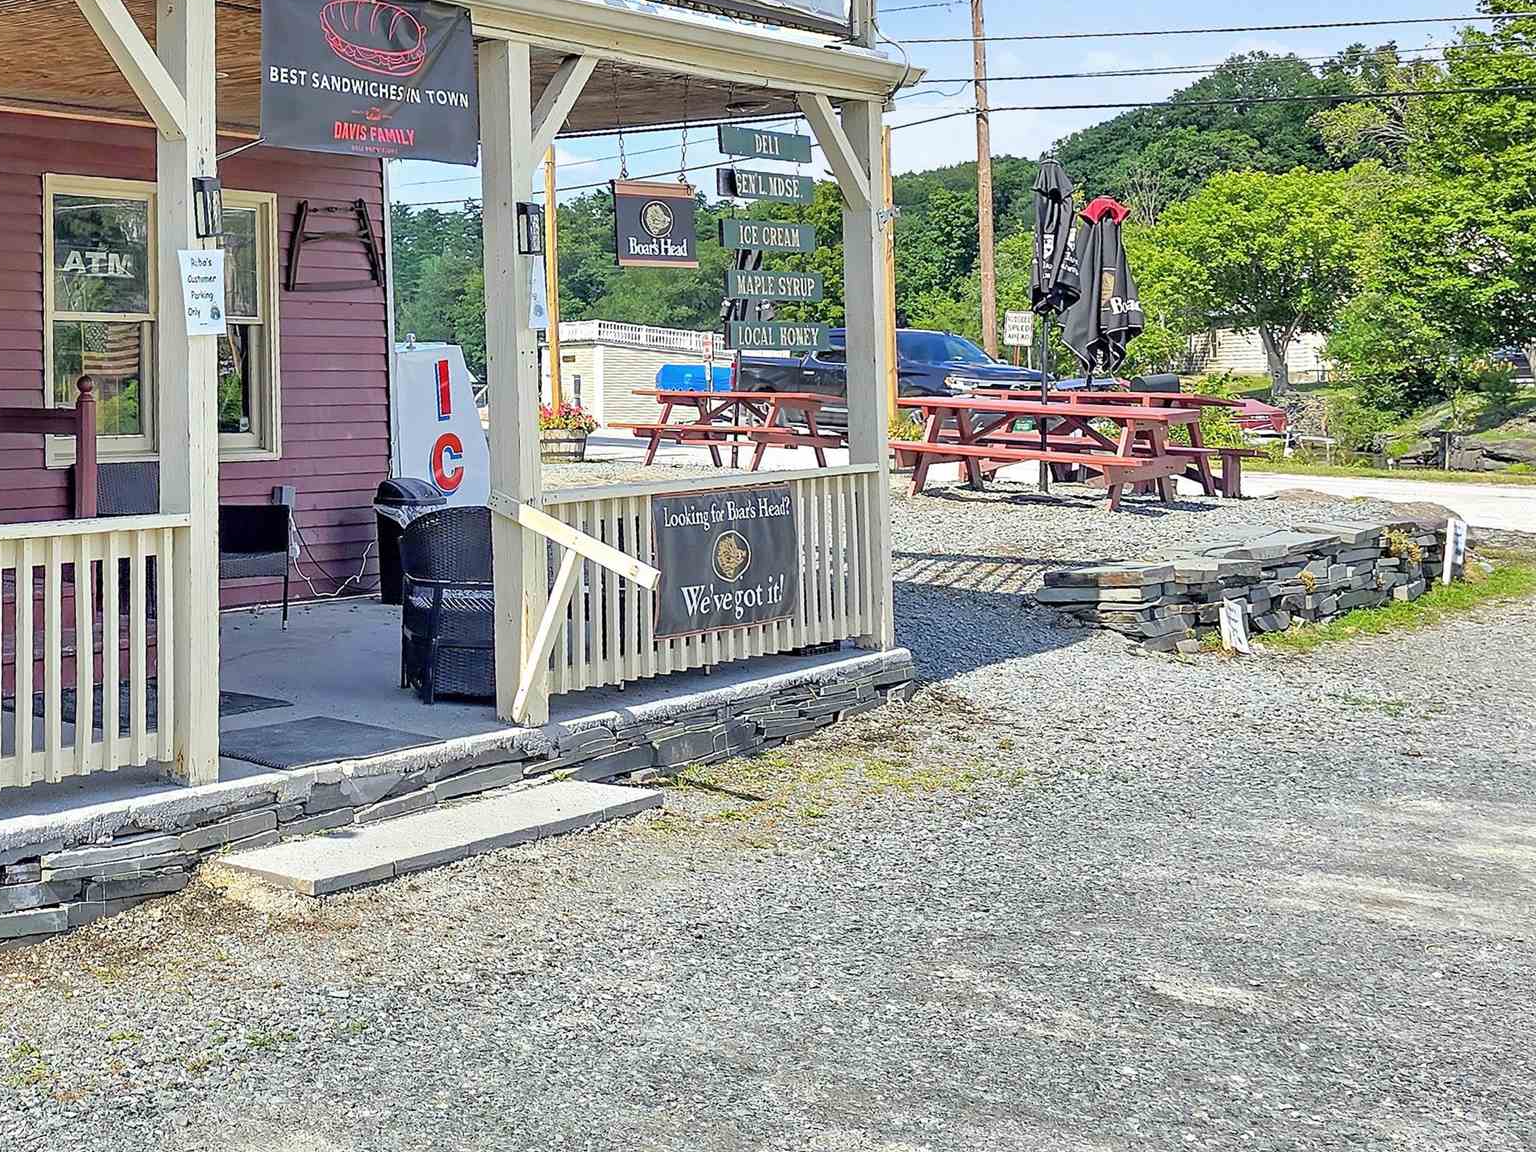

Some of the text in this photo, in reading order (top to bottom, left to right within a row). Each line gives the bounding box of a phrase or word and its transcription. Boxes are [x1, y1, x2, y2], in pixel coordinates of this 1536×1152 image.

[269, 65, 470, 109] BEST SANDWICHES IN TOWN
[333, 120, 415, 147] DAVIS FAMILY
[754, 133, 780, 155] DELI
[768, 176, 804, 199] MDSE.
[628, 236, 688, 257] Boar's Head
[739, 224, 801, 248] ICE CREAM
[63, 250, 133, 276] ATM
[736, 274, 815, 297] MAPLE SYRUP
[738, 326, 820, 347] LOCAL HONEY
[429, 359, 465, 498] IC
[664, 505, 711, 532] Looking
[711, 503, 725, 524] for
[758, 496, 791, 519] Head?
[680, 573, 785, 620] We've got it!
